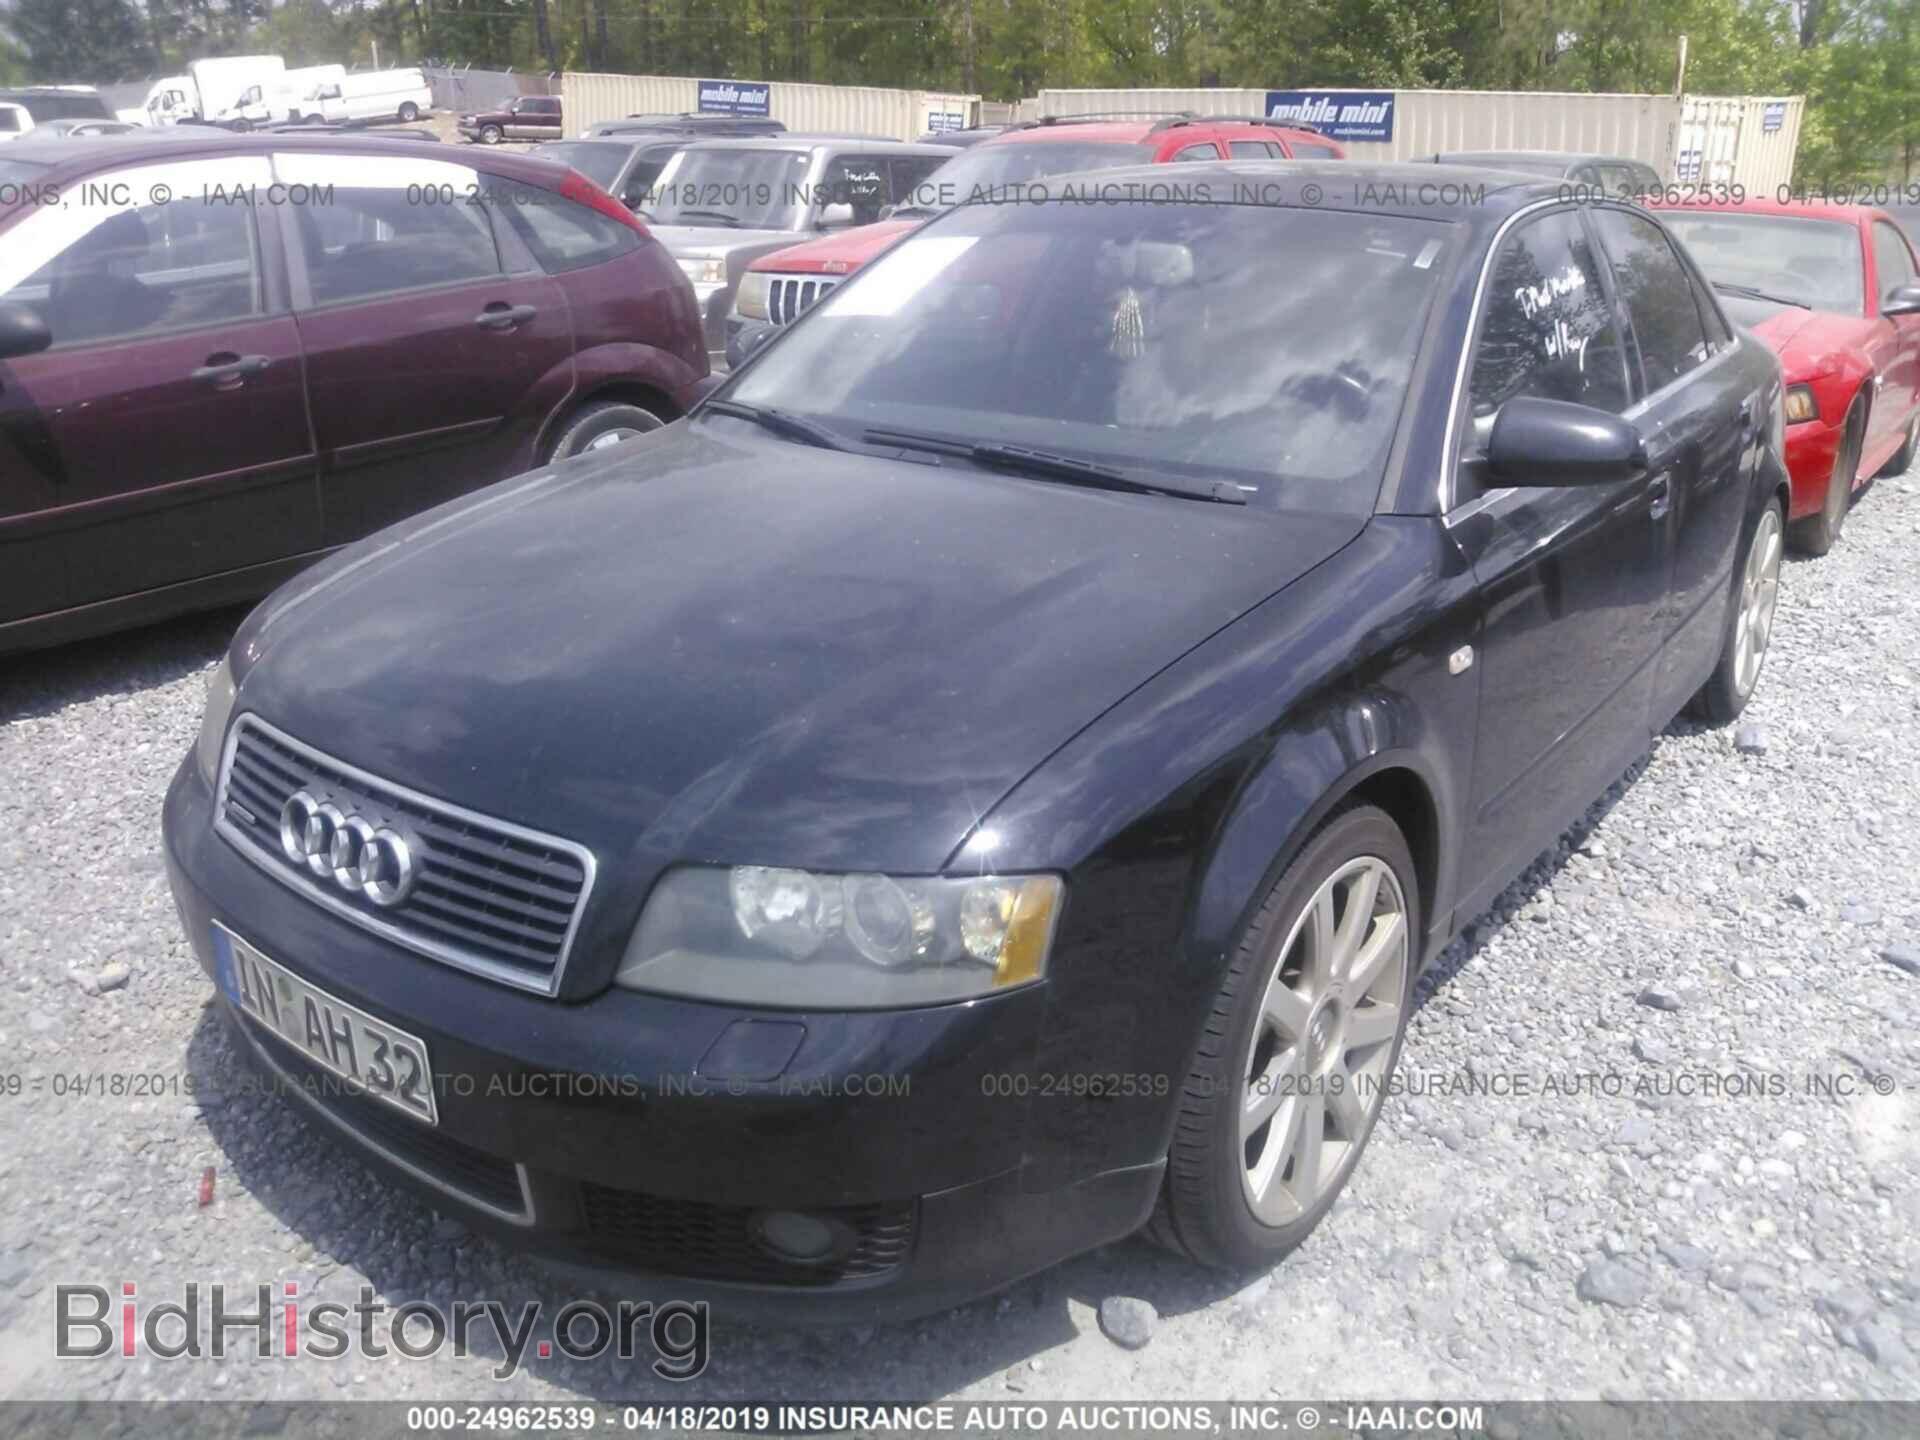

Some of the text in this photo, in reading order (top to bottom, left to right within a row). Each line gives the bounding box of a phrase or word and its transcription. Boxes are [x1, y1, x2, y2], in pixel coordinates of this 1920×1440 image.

[1271, 97, 1392, 123] mobile mini
[304, 994, 361, 1077] AH
[363, 1026, 429, 1112] 32
